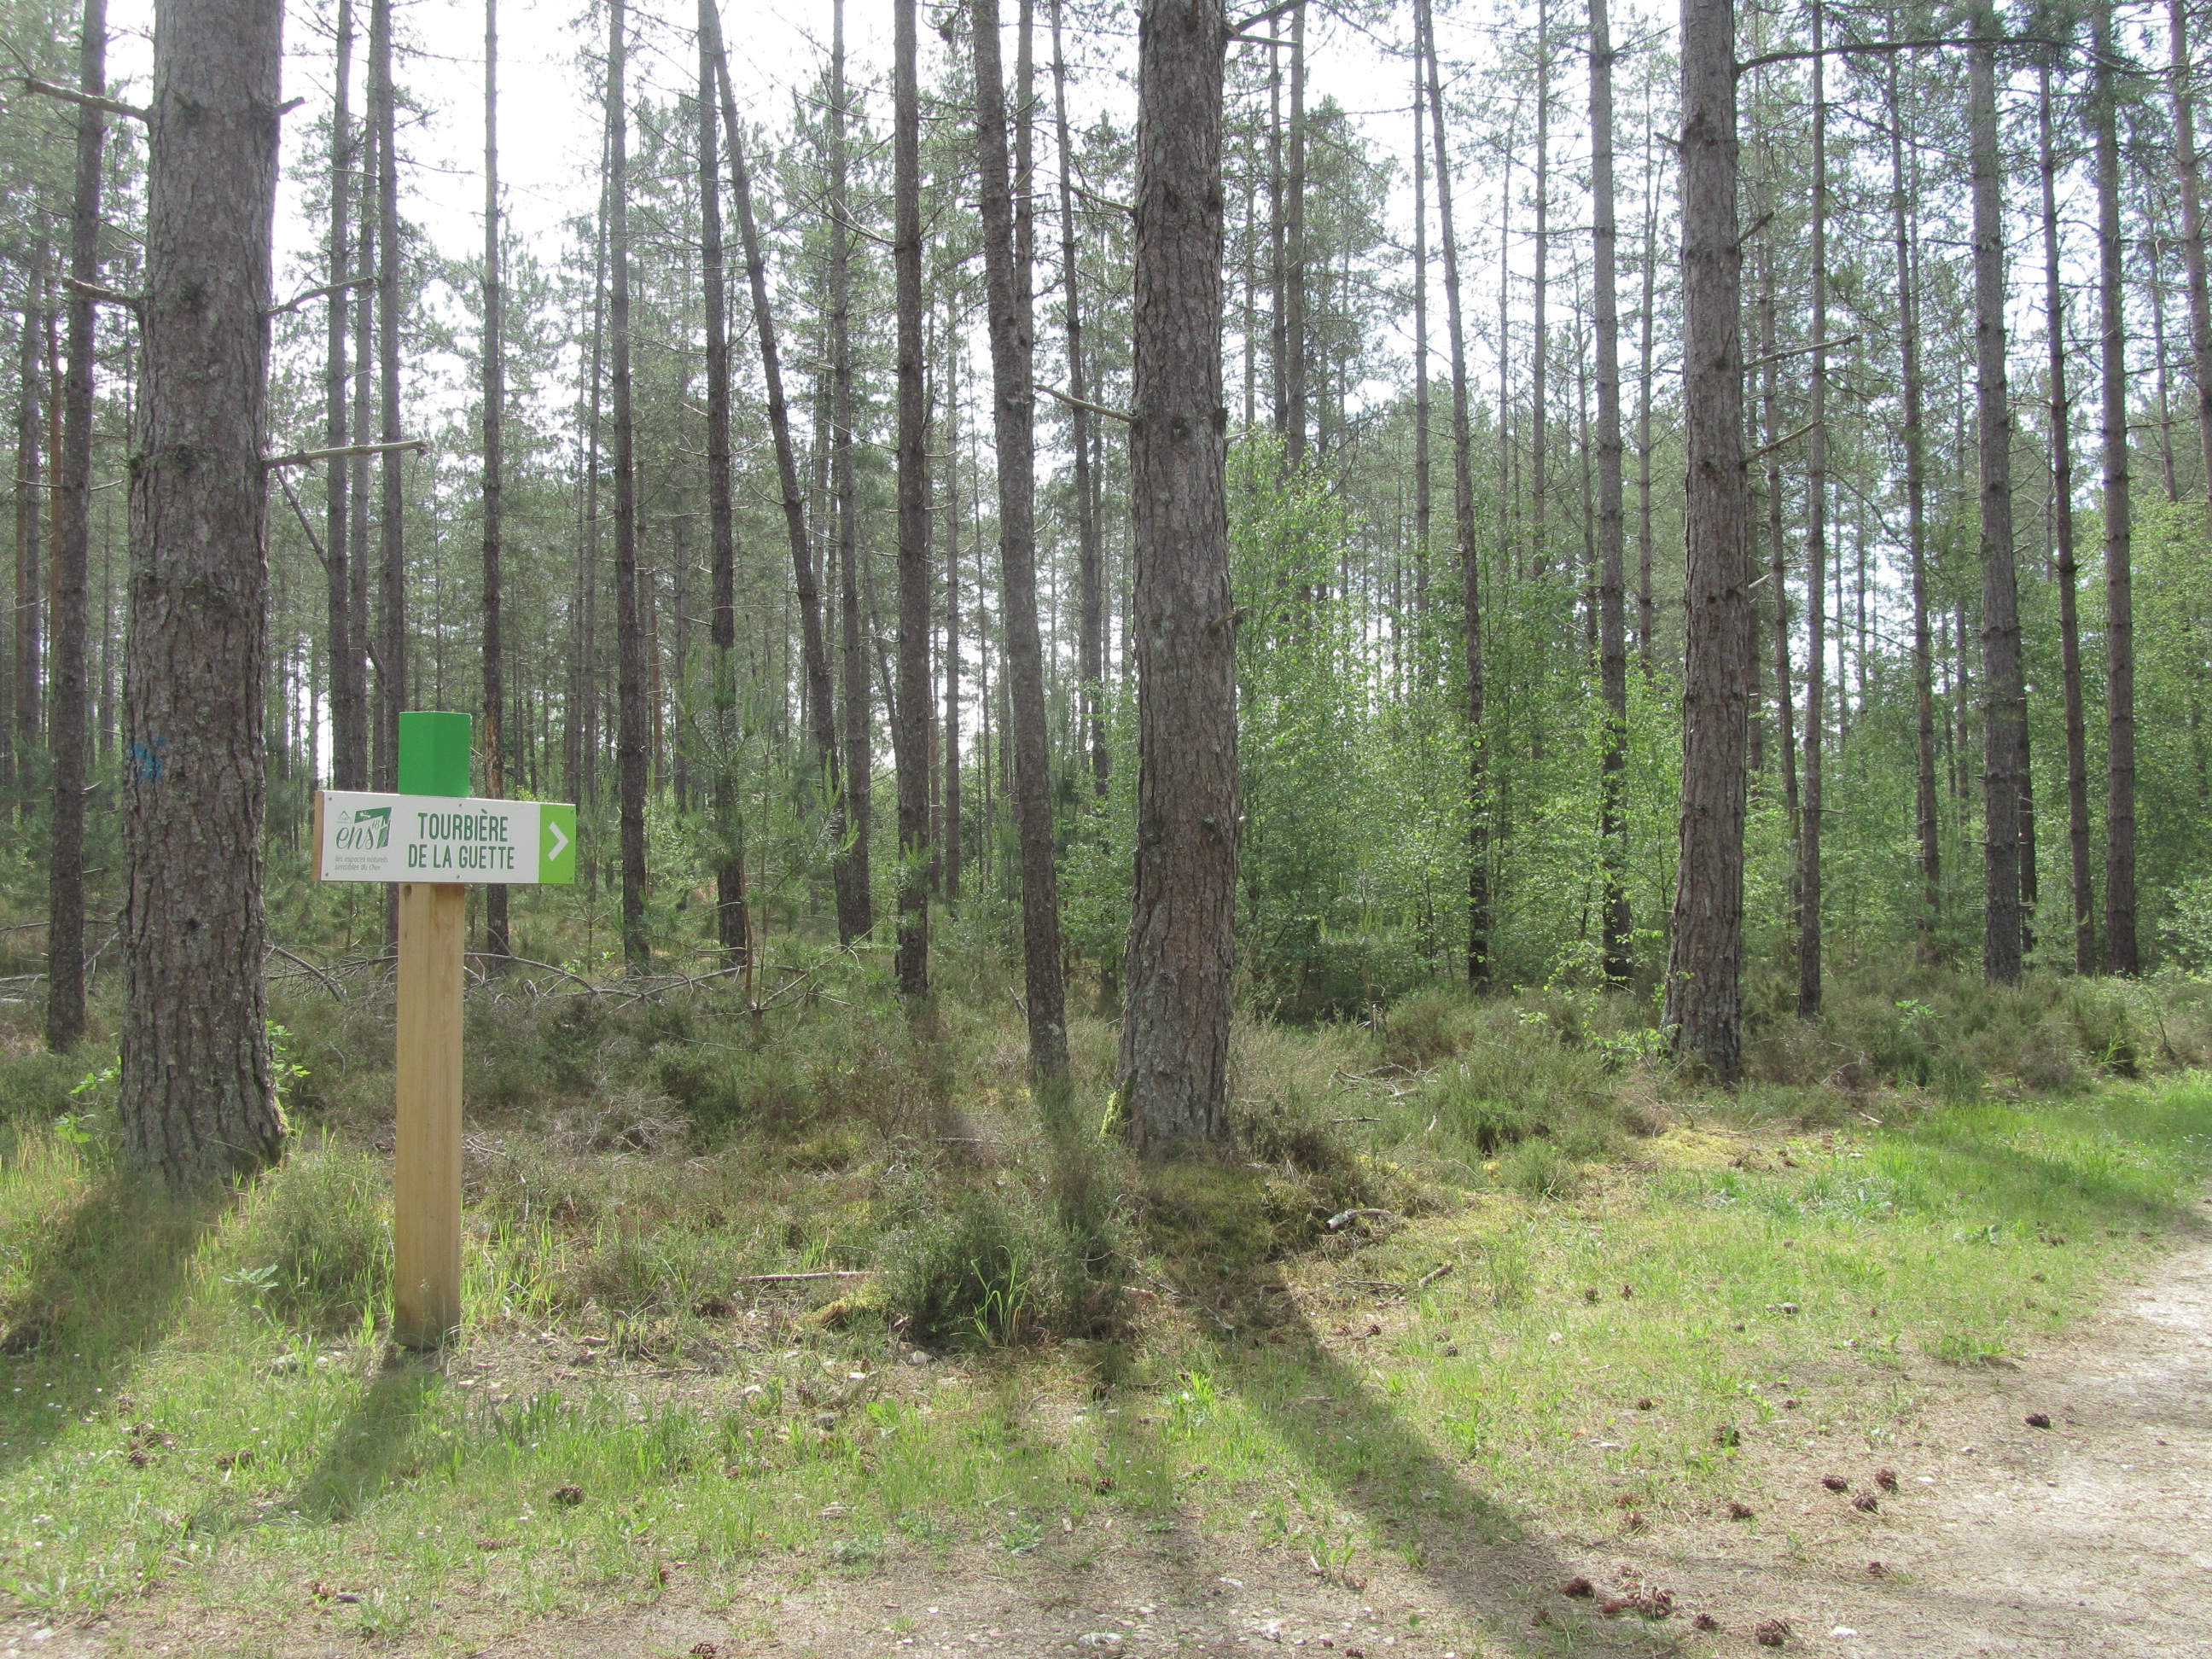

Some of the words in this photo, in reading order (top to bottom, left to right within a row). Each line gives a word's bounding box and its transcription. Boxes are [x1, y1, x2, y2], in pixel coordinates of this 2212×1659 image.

[336, 826, 374, 850] ens
[417, 809, 509, 842] TOURBIÈRE
[344, 855, 365, 864] espaces
[408, 843, 427, 868] DE
[434, 845, 452, 869] LA
[459, 845, 515, 870] GUETTE
